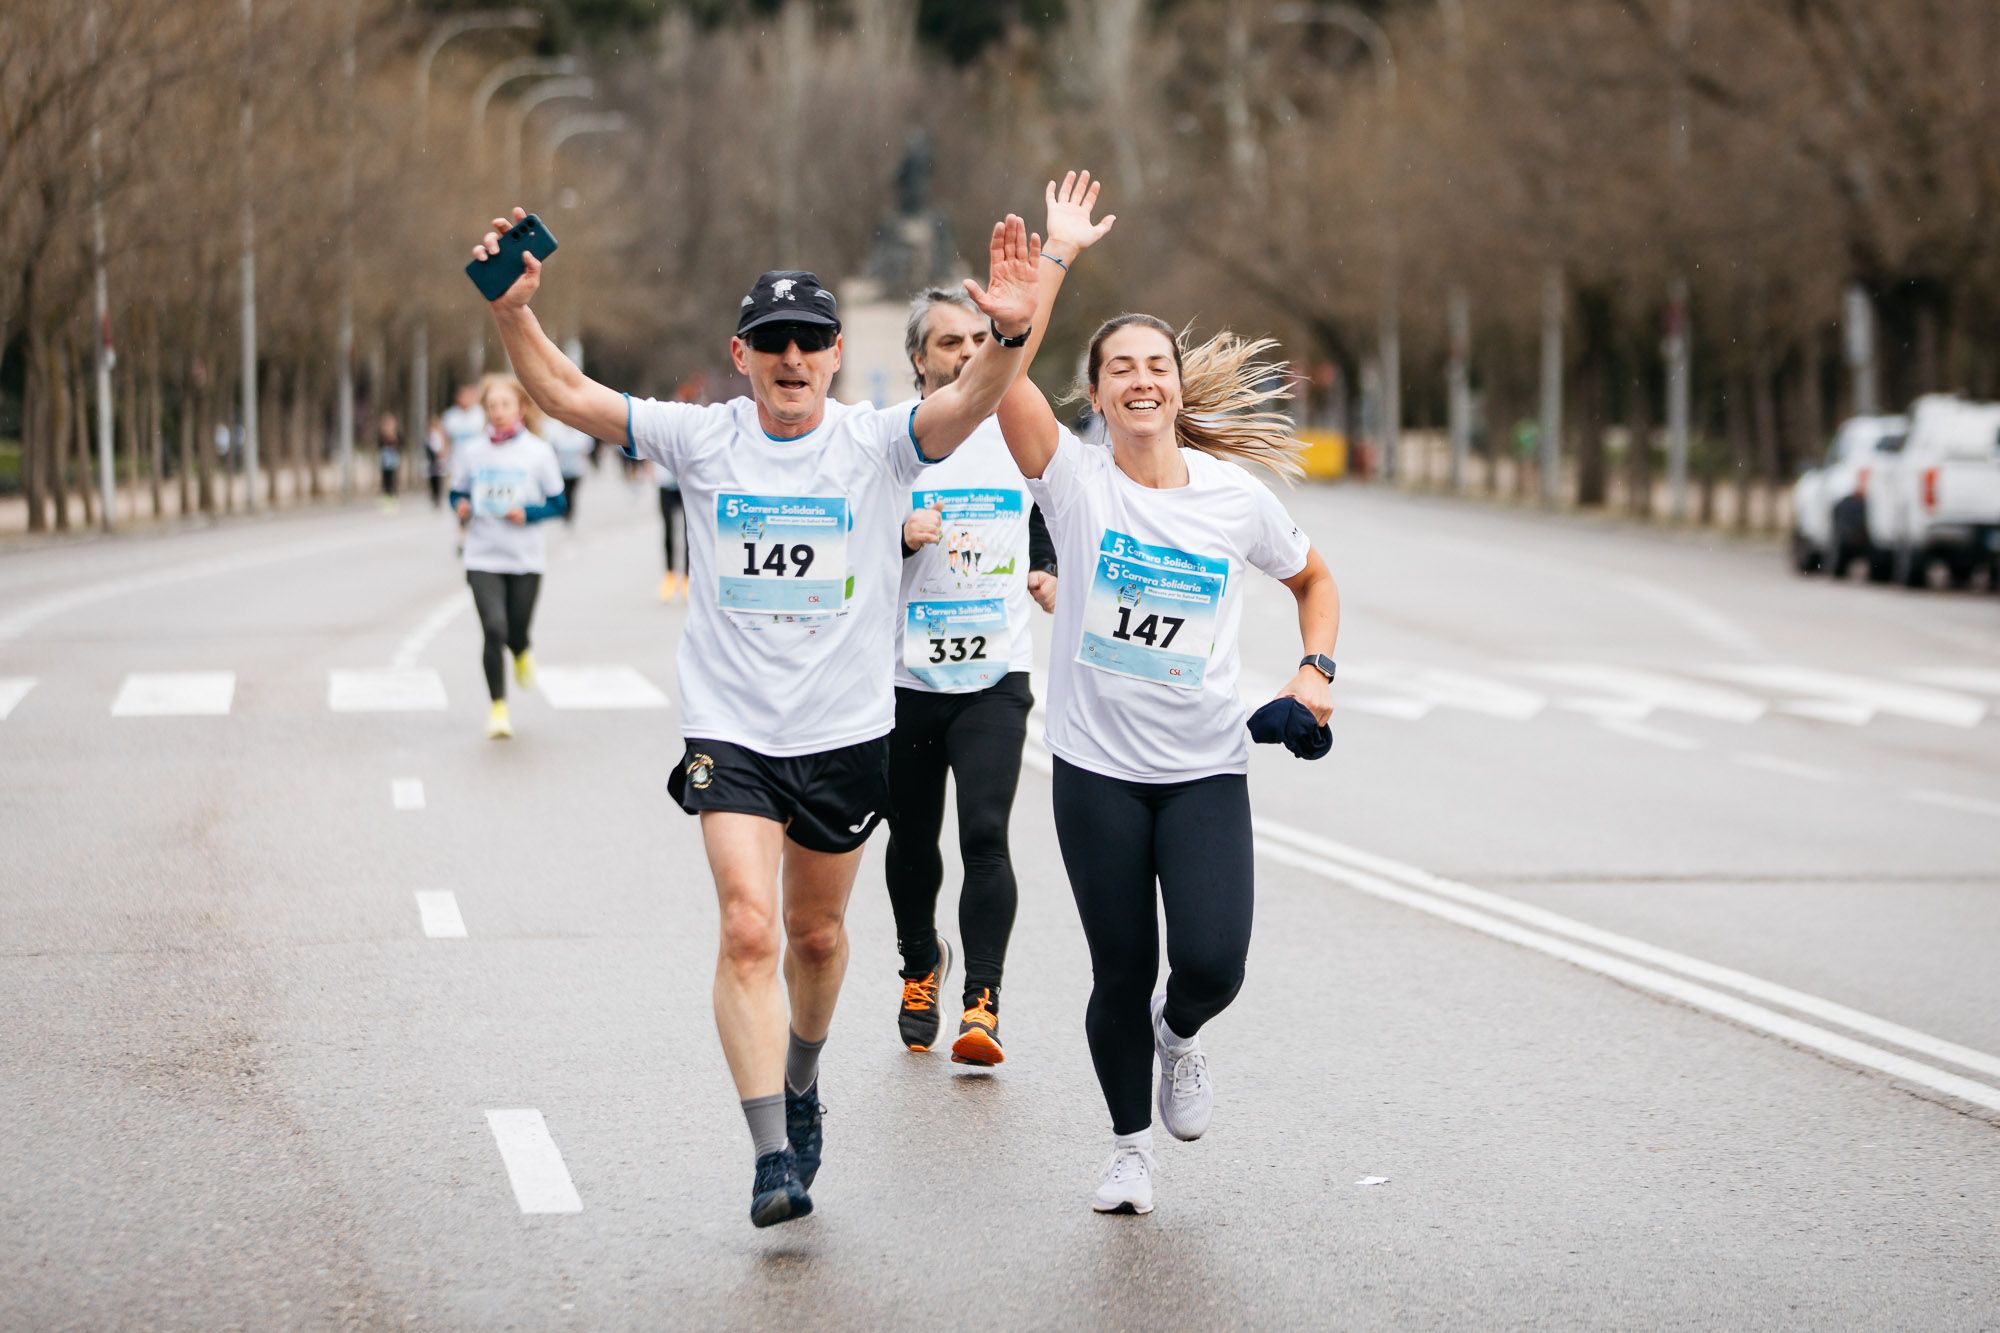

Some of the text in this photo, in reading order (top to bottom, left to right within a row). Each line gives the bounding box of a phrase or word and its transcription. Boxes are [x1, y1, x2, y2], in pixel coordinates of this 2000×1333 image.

[740, 503, 779, 514] Carrera
[781, 504, 826, 516] Solidaria
[743, 543, 815, 577] 149
[1128, 546, 1161, 563] Carrera
[1163, 556, 1207, 573] Solidaria
[1122, 569, 1159, 586] Carrera
[1160, 578, 1202, 593] Solidaria
[927, 608, 957, 616] Carrera
[958, 605, 992, 615] Solidaria
[1112, 606, 1185, 648] 147
[929, 636, 987, 663] 332
